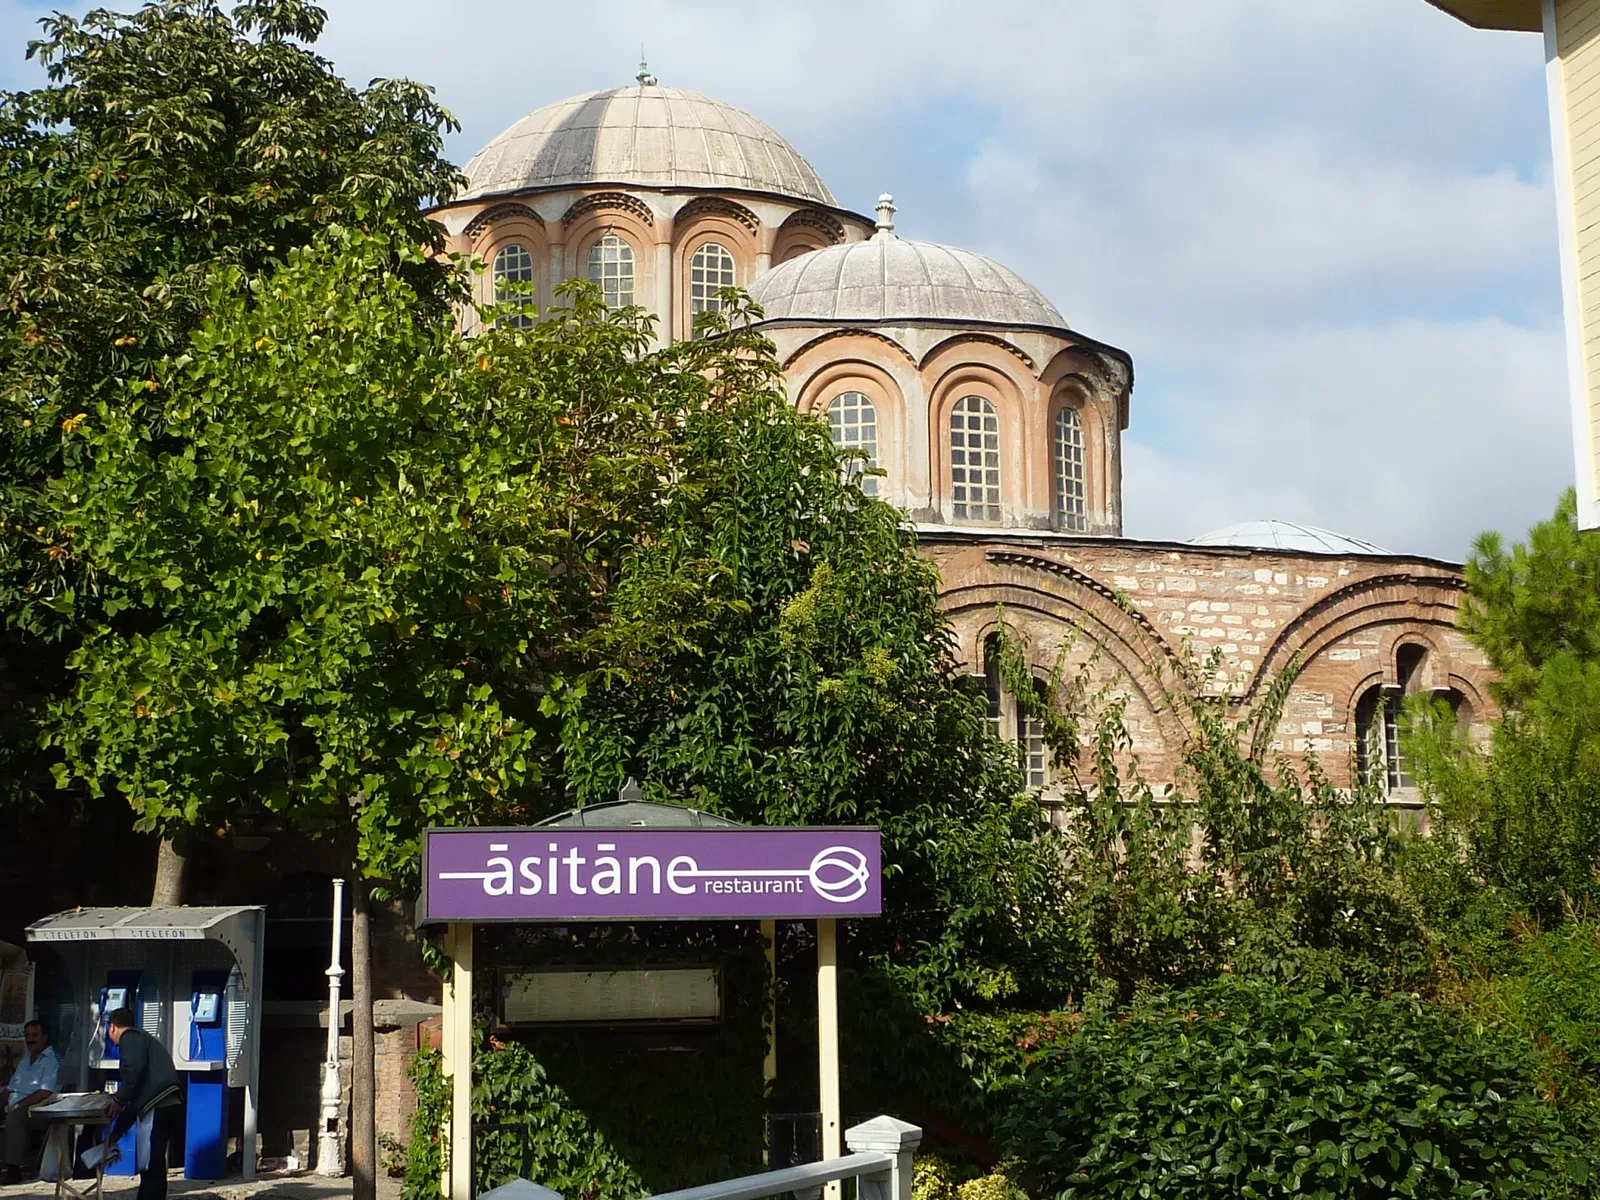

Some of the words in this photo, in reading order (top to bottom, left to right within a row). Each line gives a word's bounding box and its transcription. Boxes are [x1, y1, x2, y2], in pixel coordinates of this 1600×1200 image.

[483, 843, 698, 896] āsitāne
[705, 877, 803, 894] restaurant
[51, 930, 97, 939] TELEFON
[139, 930, 186, 938] TELEFON
